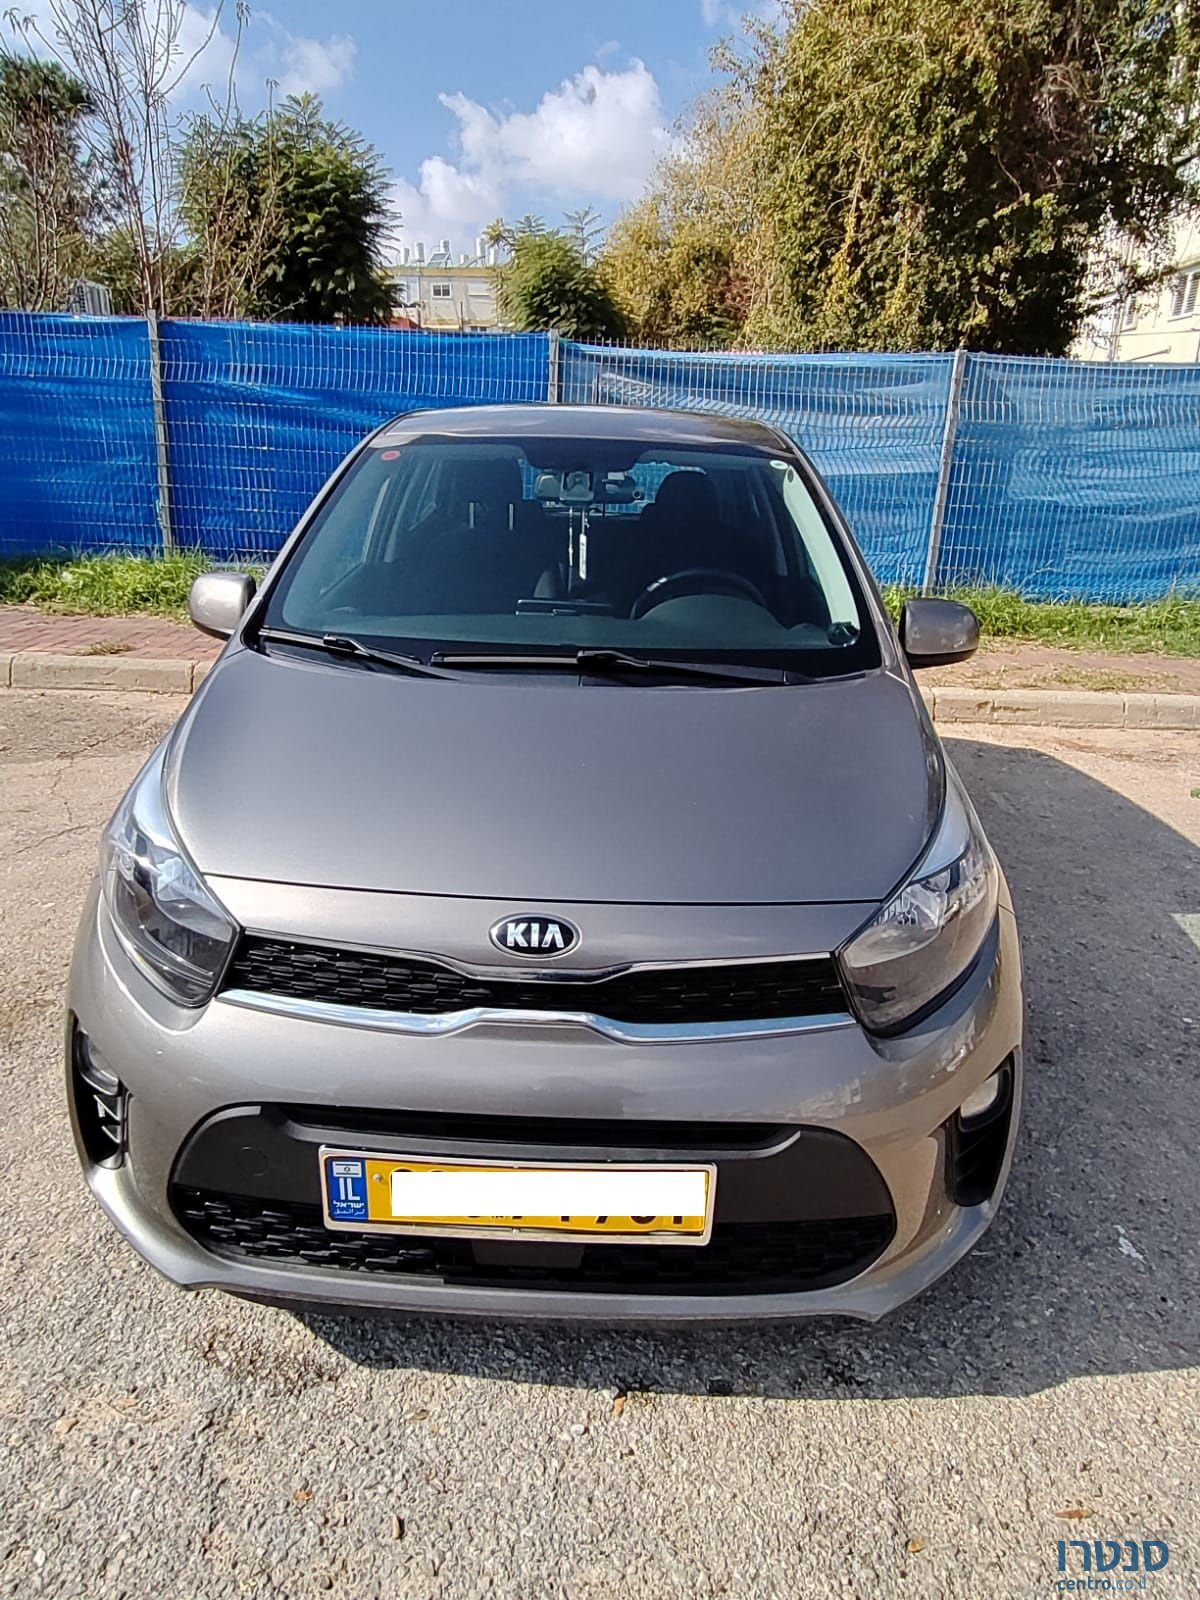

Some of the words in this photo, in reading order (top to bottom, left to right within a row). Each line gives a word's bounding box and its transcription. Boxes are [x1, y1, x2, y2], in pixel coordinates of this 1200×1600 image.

[507, 922, 565, 948] KIA
[339, 1177, 361, 1201] IL
[333, 1200, 365, 1209] ישראל
